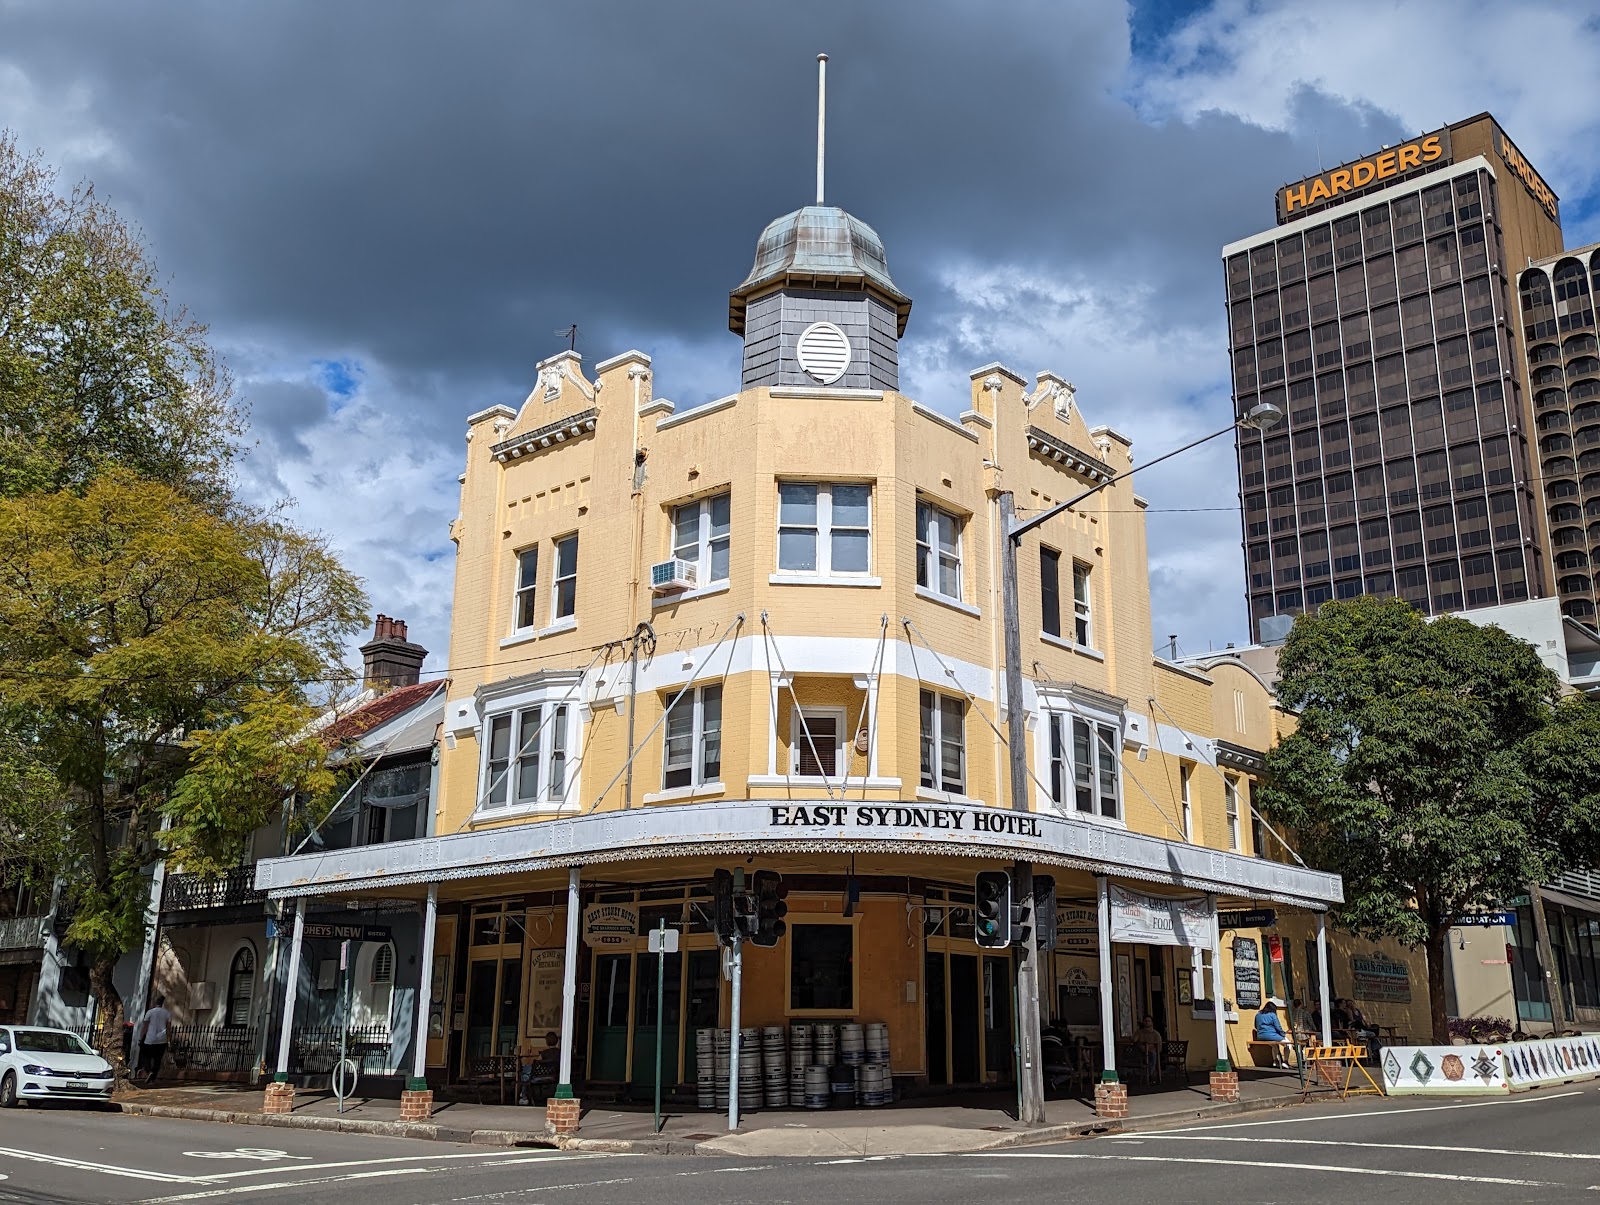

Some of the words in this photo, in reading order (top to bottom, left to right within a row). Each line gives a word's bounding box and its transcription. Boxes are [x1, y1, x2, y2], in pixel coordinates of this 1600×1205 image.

[1286, 136, 1443, 211] HARDERS
[1501, 133, 1557, 217] HARDERS
[770, 806, 848, 826] EAST
[856, 807, 966, 829] SYDNEY
[972, 812, 1042, 838] HOTEL
[588, 909, 601, 923] EAST
[602, 906, 620, 917] SYDNEY
[621, 908, 637, 925] HOTEL
[1066, 910, 1087, 920] SYDNEY
[1219, 914, 1239, 926] EW
[303, 925, 332, 936] OHEYS
[335, 926, 362, 938] NEW
[1152, 917, 1174, 931] FOOD
